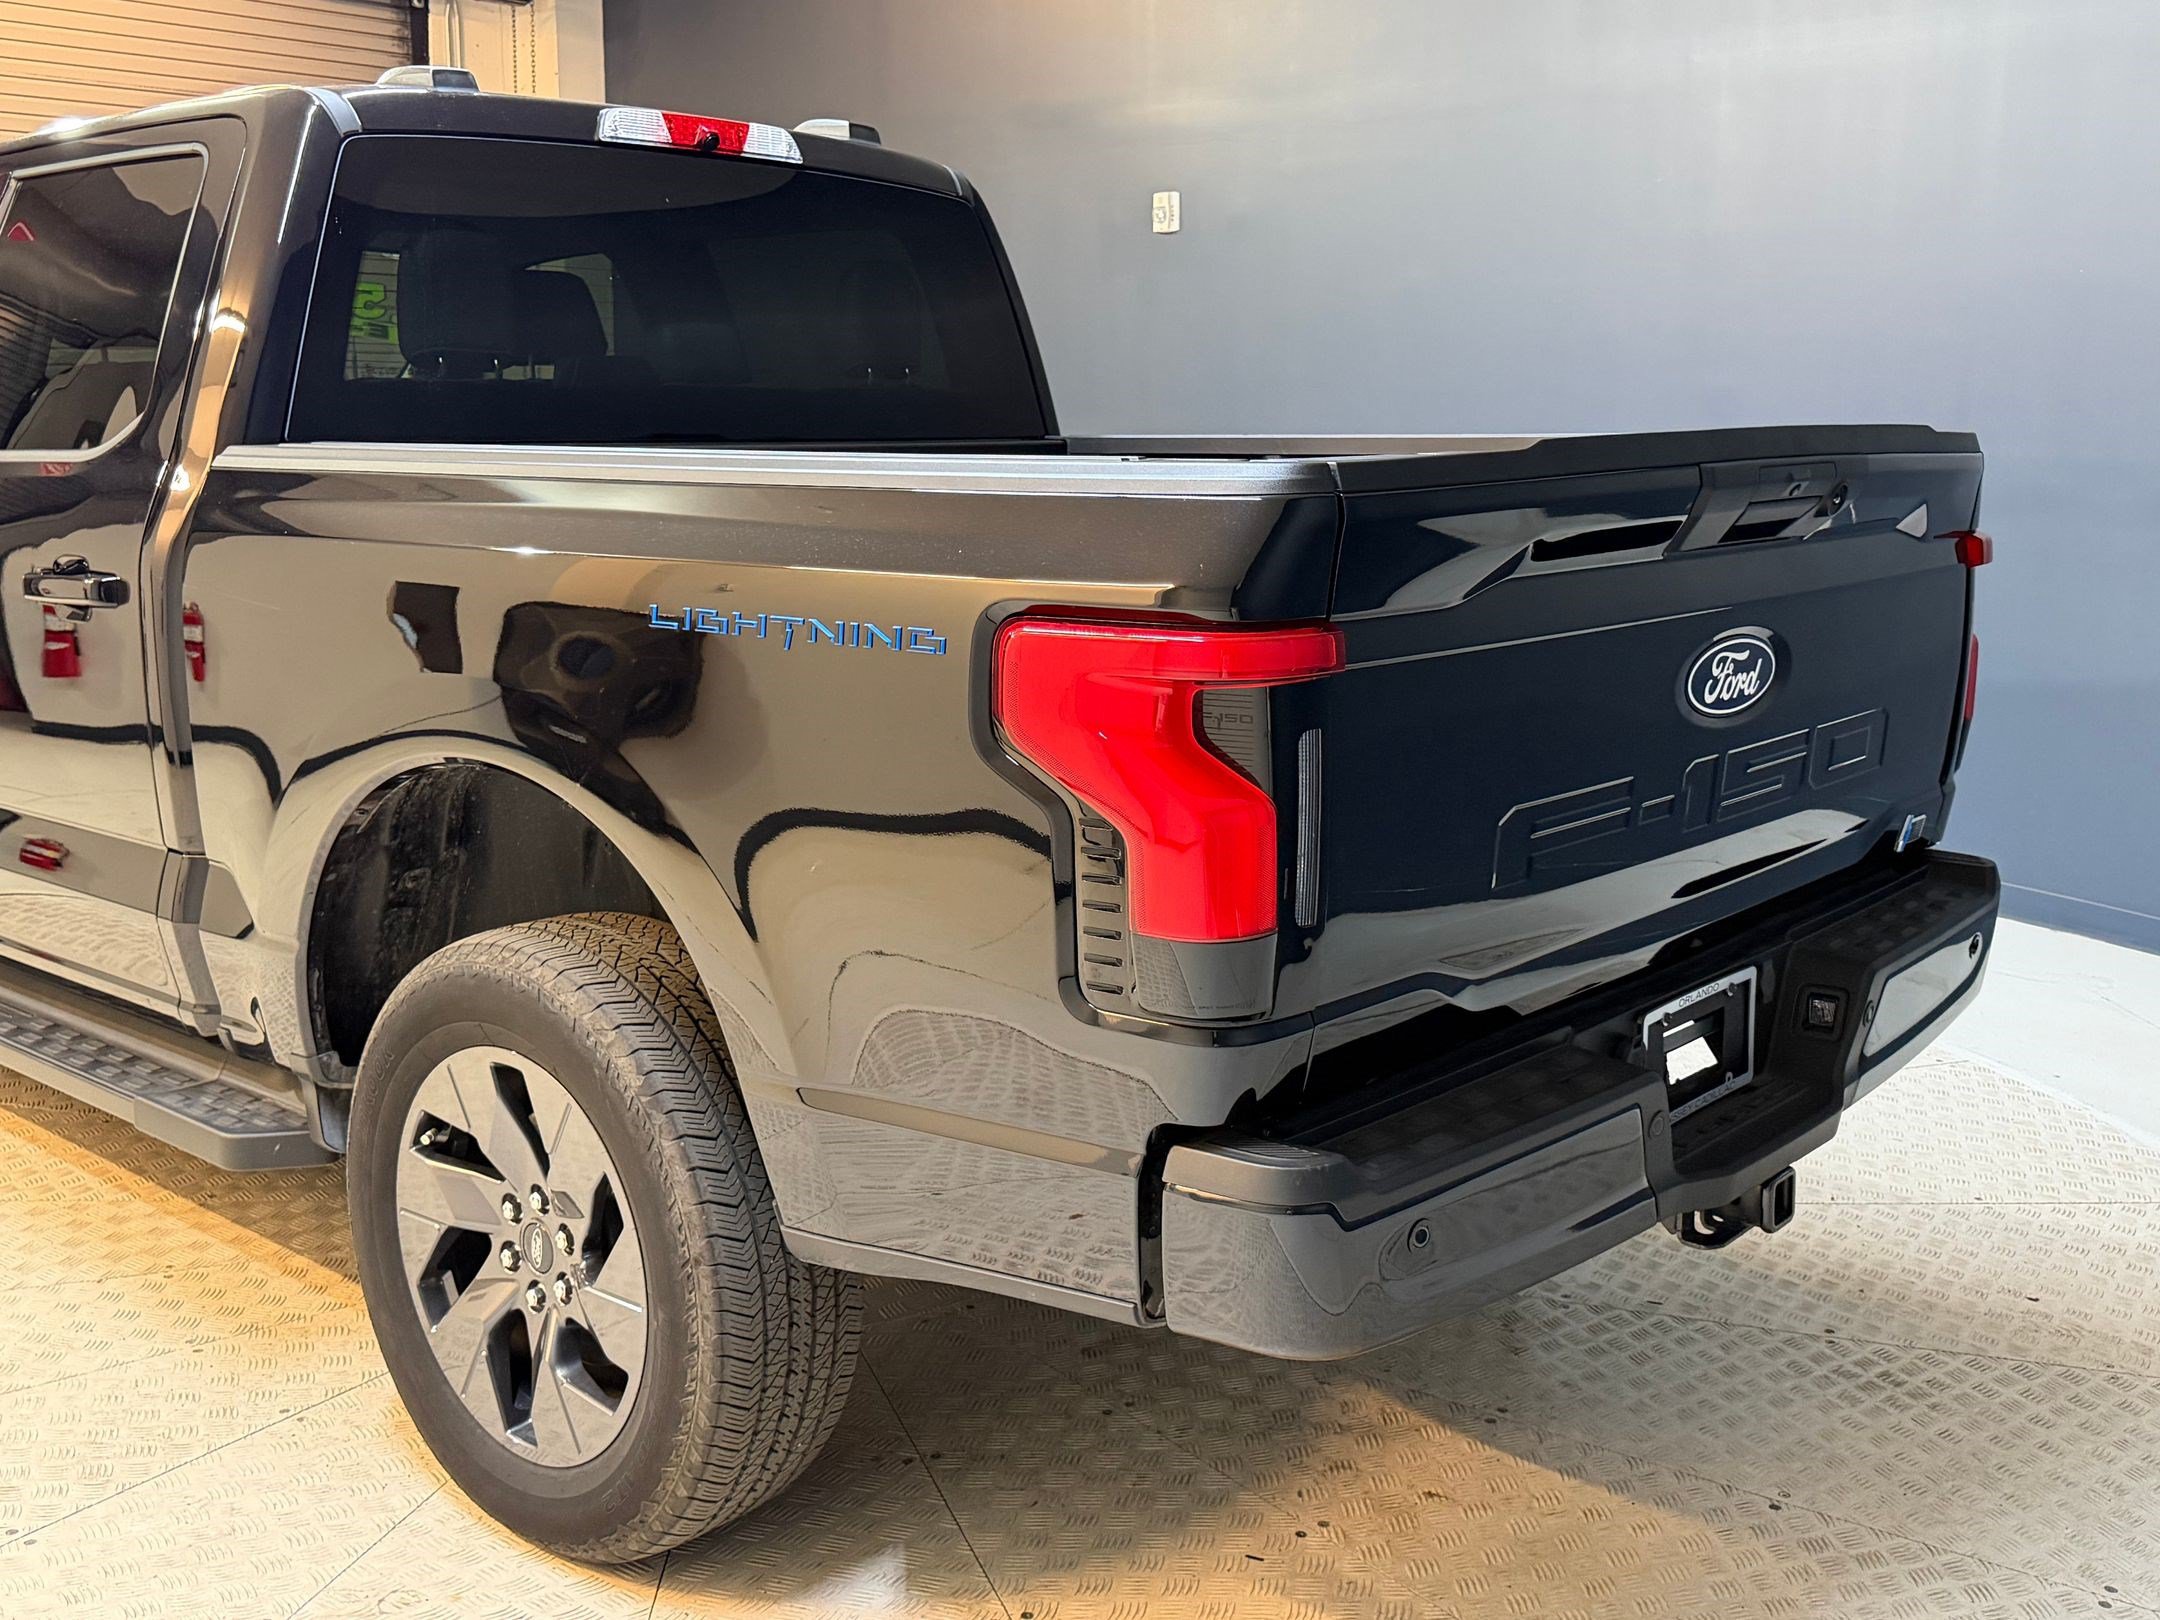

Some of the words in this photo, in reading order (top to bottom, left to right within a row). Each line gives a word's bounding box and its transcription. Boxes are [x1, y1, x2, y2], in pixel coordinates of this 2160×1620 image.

[648, 604, 947, 655] LIGHTNING
[1704, 648, 1763, 704] Ford
[1491, 708, 1888, 890] F-150
[1678, 982, 1720, 1008] ORLANDO
